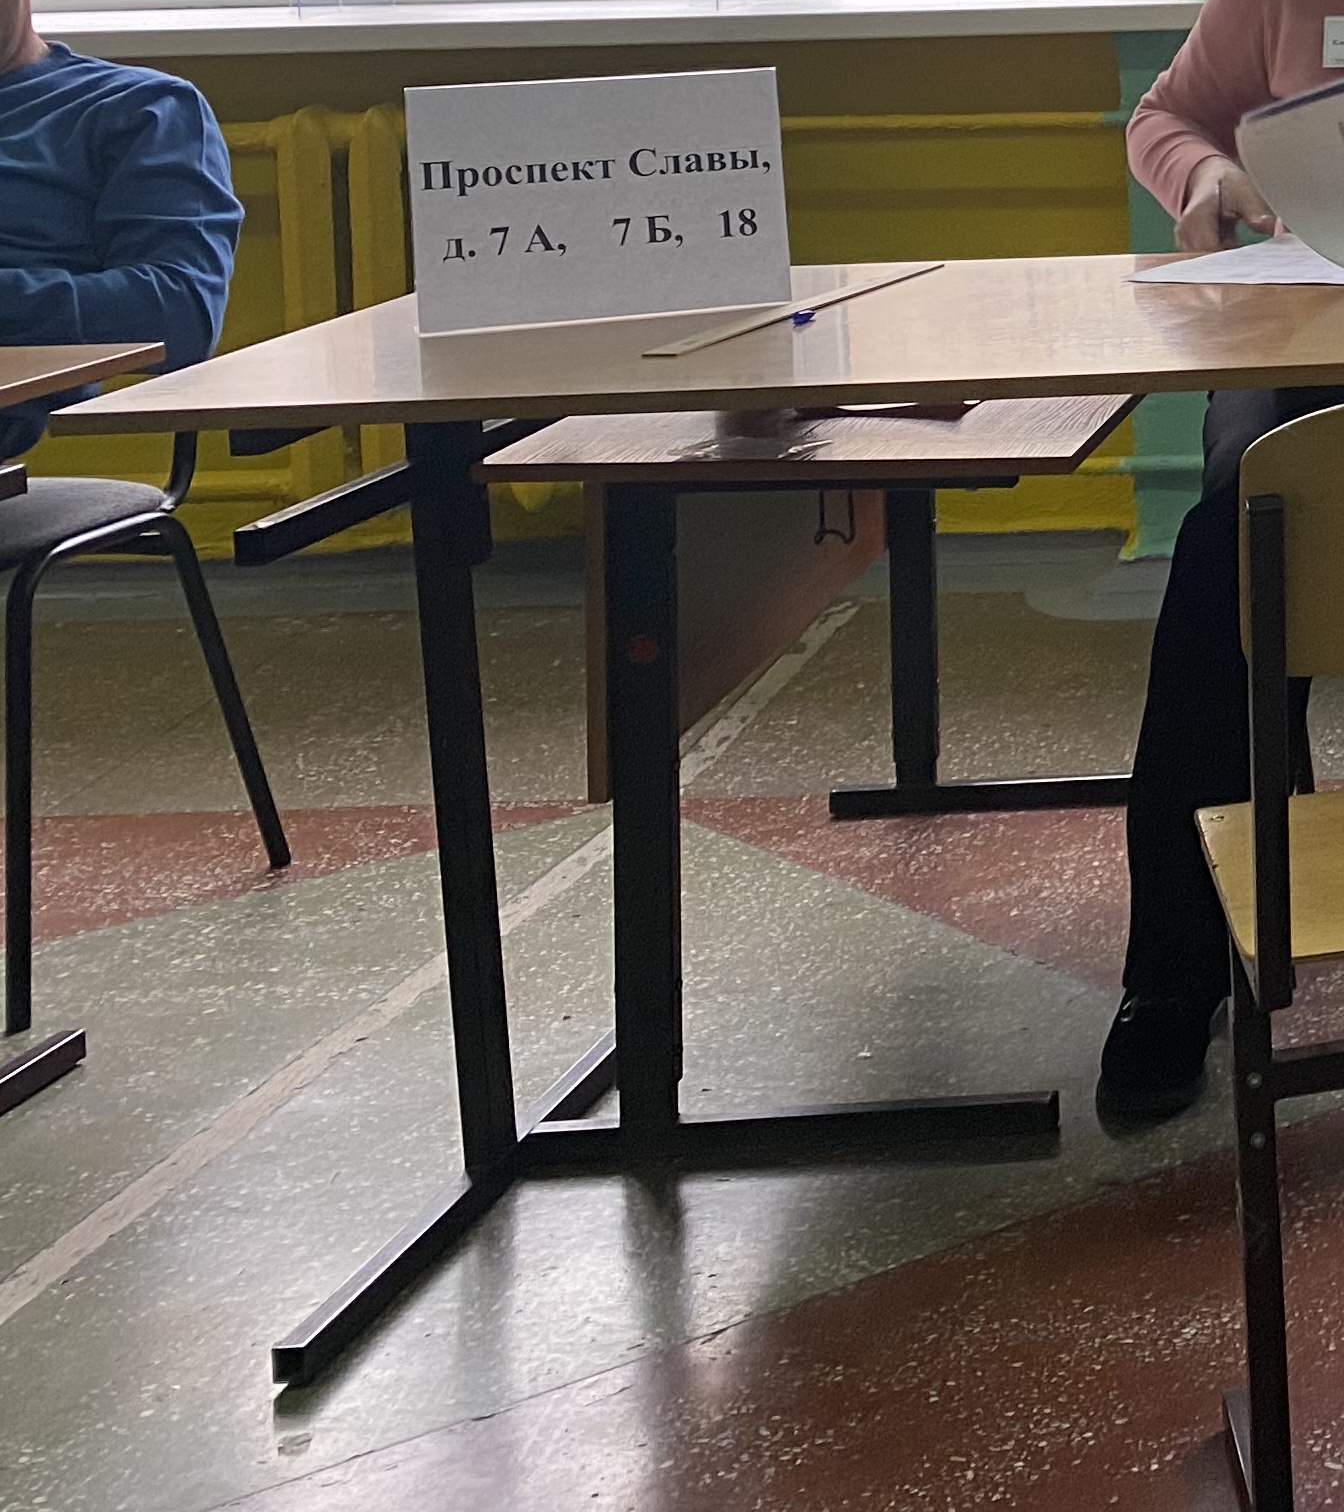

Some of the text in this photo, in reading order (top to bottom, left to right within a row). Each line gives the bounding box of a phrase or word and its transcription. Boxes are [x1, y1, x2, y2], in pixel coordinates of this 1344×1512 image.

[419, 147, 771, 197] Проспект Славы,
[442, 208, 758, 264] д. 7 А, 7 Б, 18
